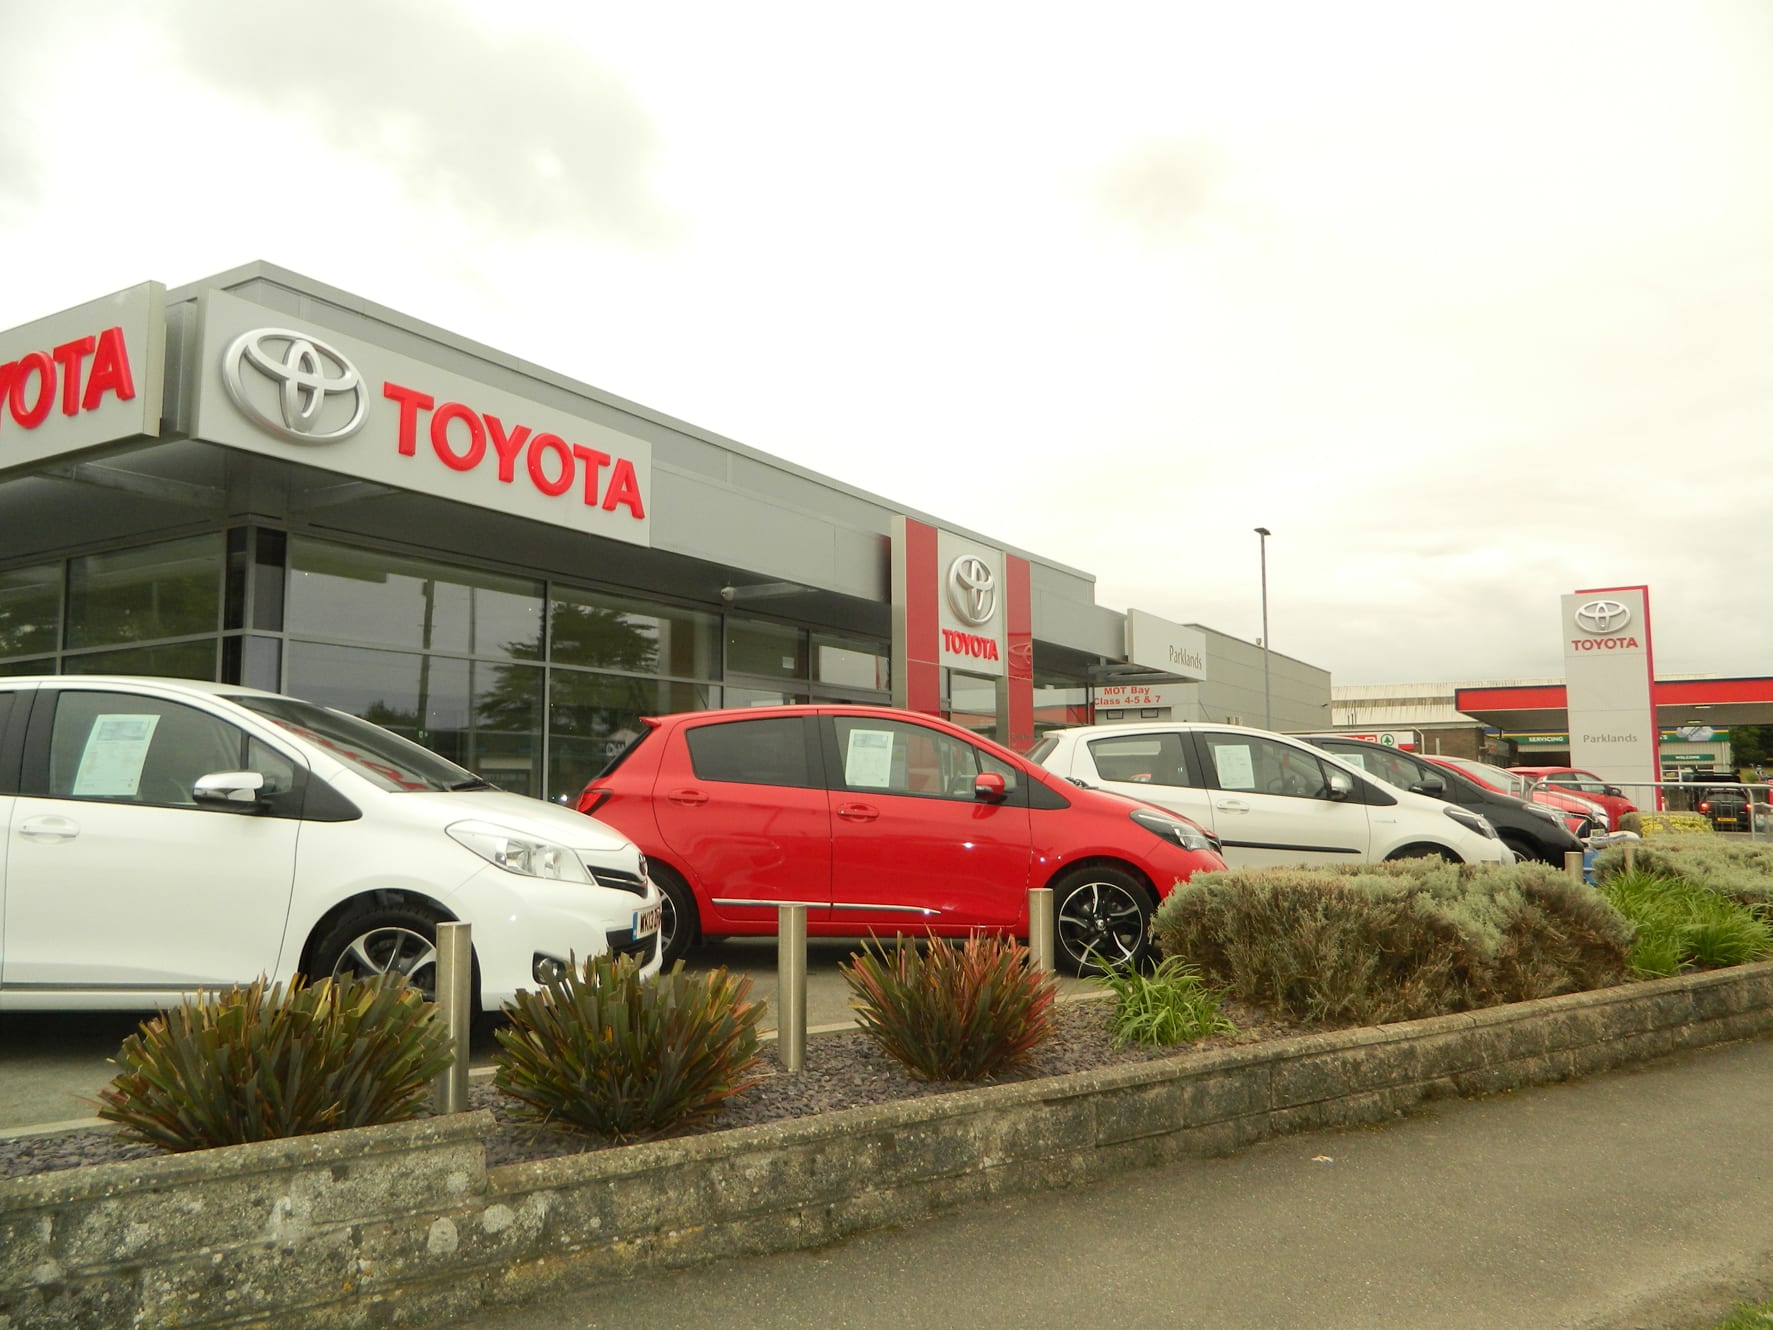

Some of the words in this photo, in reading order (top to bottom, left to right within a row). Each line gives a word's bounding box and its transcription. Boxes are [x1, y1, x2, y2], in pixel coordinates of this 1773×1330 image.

[384, 381, 645, 520] TOYOTA
[942, 628, 999, 661] TOYOTA
[1571, 637, 1638, 651] TOYOTA
[1169, 644, 1202, 670] Parklands
[1104, 686, 1127, 695] MOT
[1131, 686, 1150, 695] Bay
[1094, 697, 1120, 705] Class
[1125, 696, 1140, 704] 4-5
[1144, 695, 1151, 703] &
[1155, 695, 1161, 703] 7
[1583, 733, 1637, 743] Parklands
